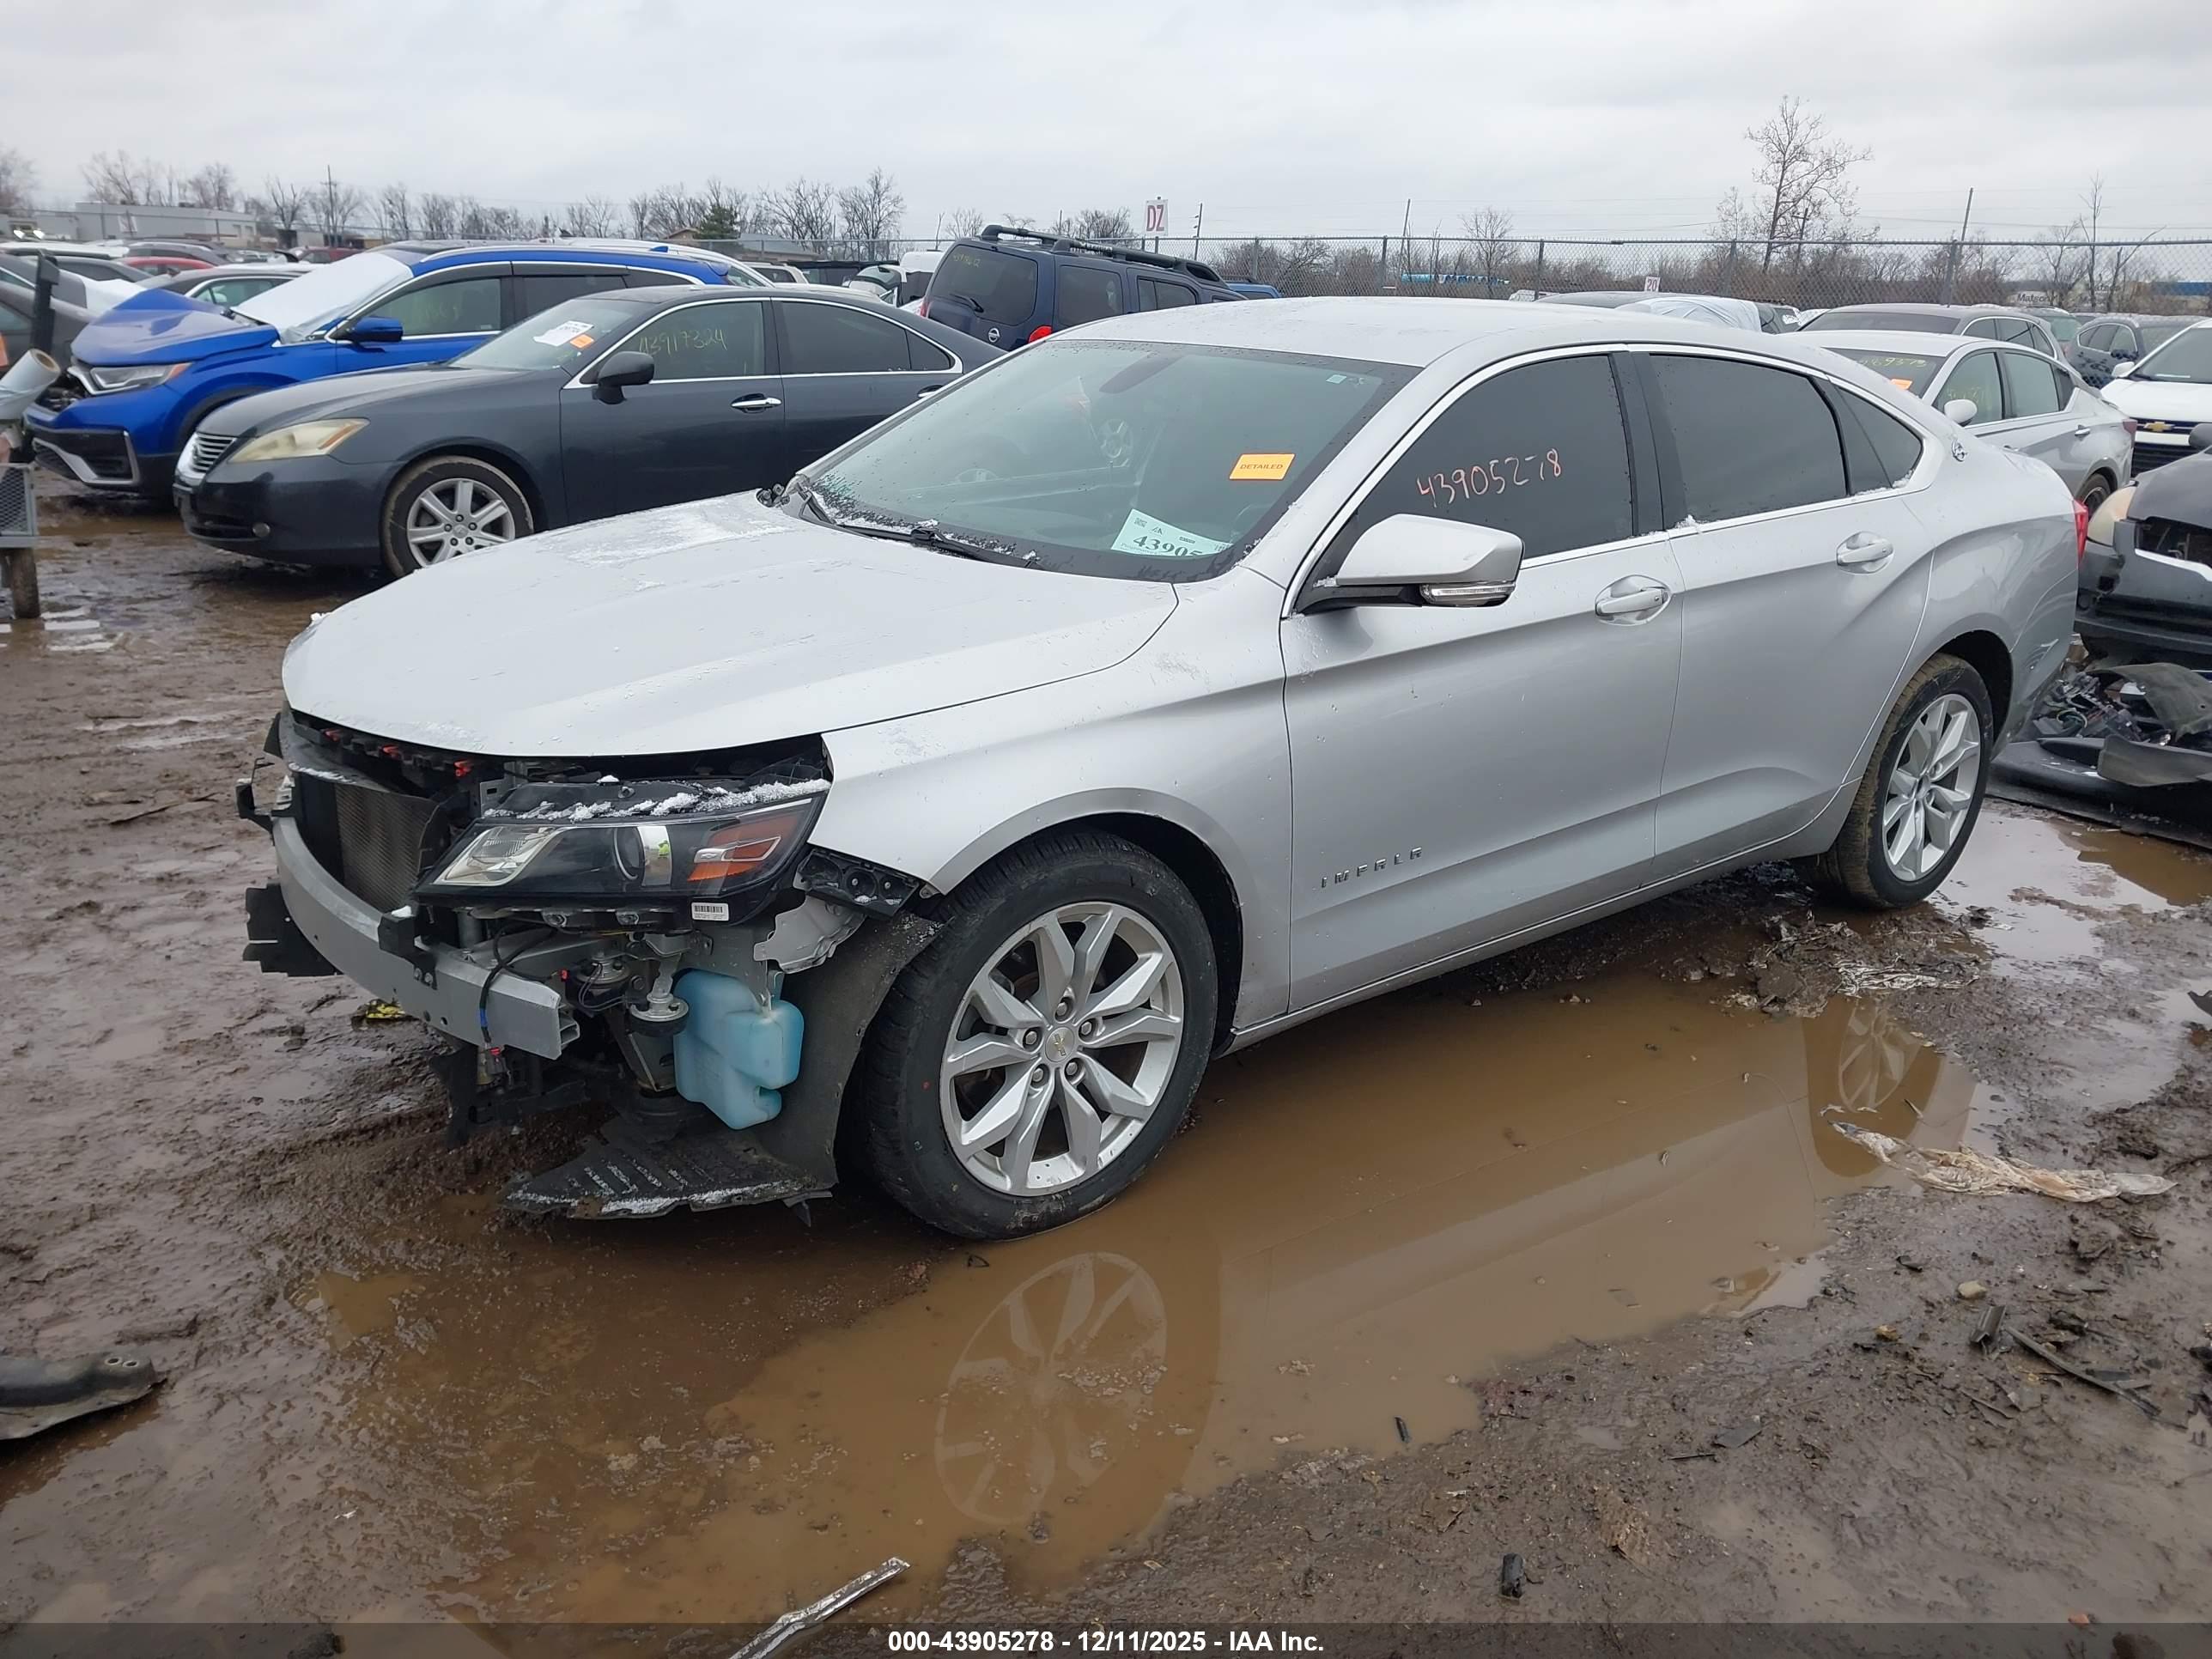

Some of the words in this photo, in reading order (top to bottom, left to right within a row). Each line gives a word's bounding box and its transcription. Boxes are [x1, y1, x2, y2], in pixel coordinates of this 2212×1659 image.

[1146, 204, 1165, 232] DZ
[1647, 279, 1658, 292] 20
[1417, 448, 1561, 508] 43905278
[1322, 847, 1422, 888] IMPALA
